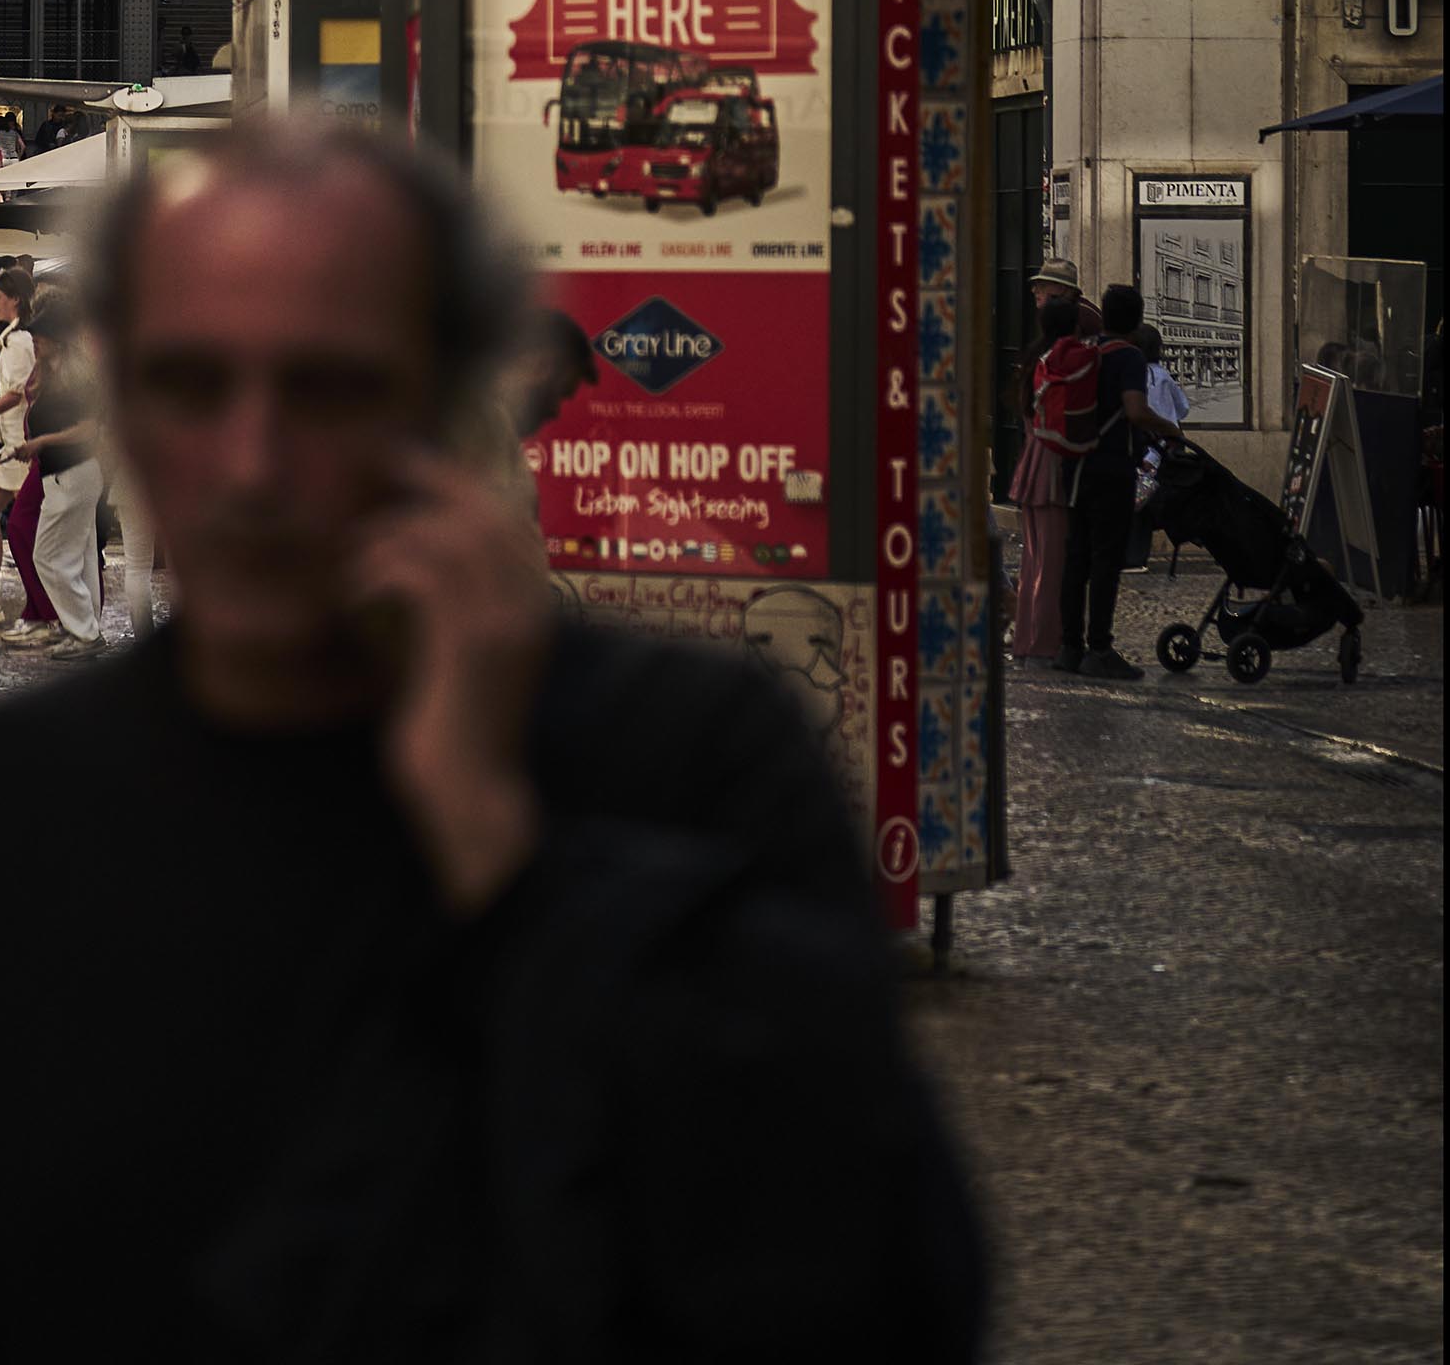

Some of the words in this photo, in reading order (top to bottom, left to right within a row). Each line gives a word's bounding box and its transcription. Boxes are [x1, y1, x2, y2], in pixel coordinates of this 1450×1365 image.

[1167, 183, 1238, 197] PIMENTA
[751, 242, 797, 258] ORIENTE
[801, 242, 824, 258] LINE
[886, 368, 910, 409] &
[552, 439, 611, 478] HOP
[619, 441, 659, 479] ON
[669, 443, 730, 481] HOP
[739, 445, 796, 482] OFF
[574, 483, 640, 517] Lisbon
[647, 486, 769, 529] Sightseeing
[883, 459, 912, 768] TOURS
